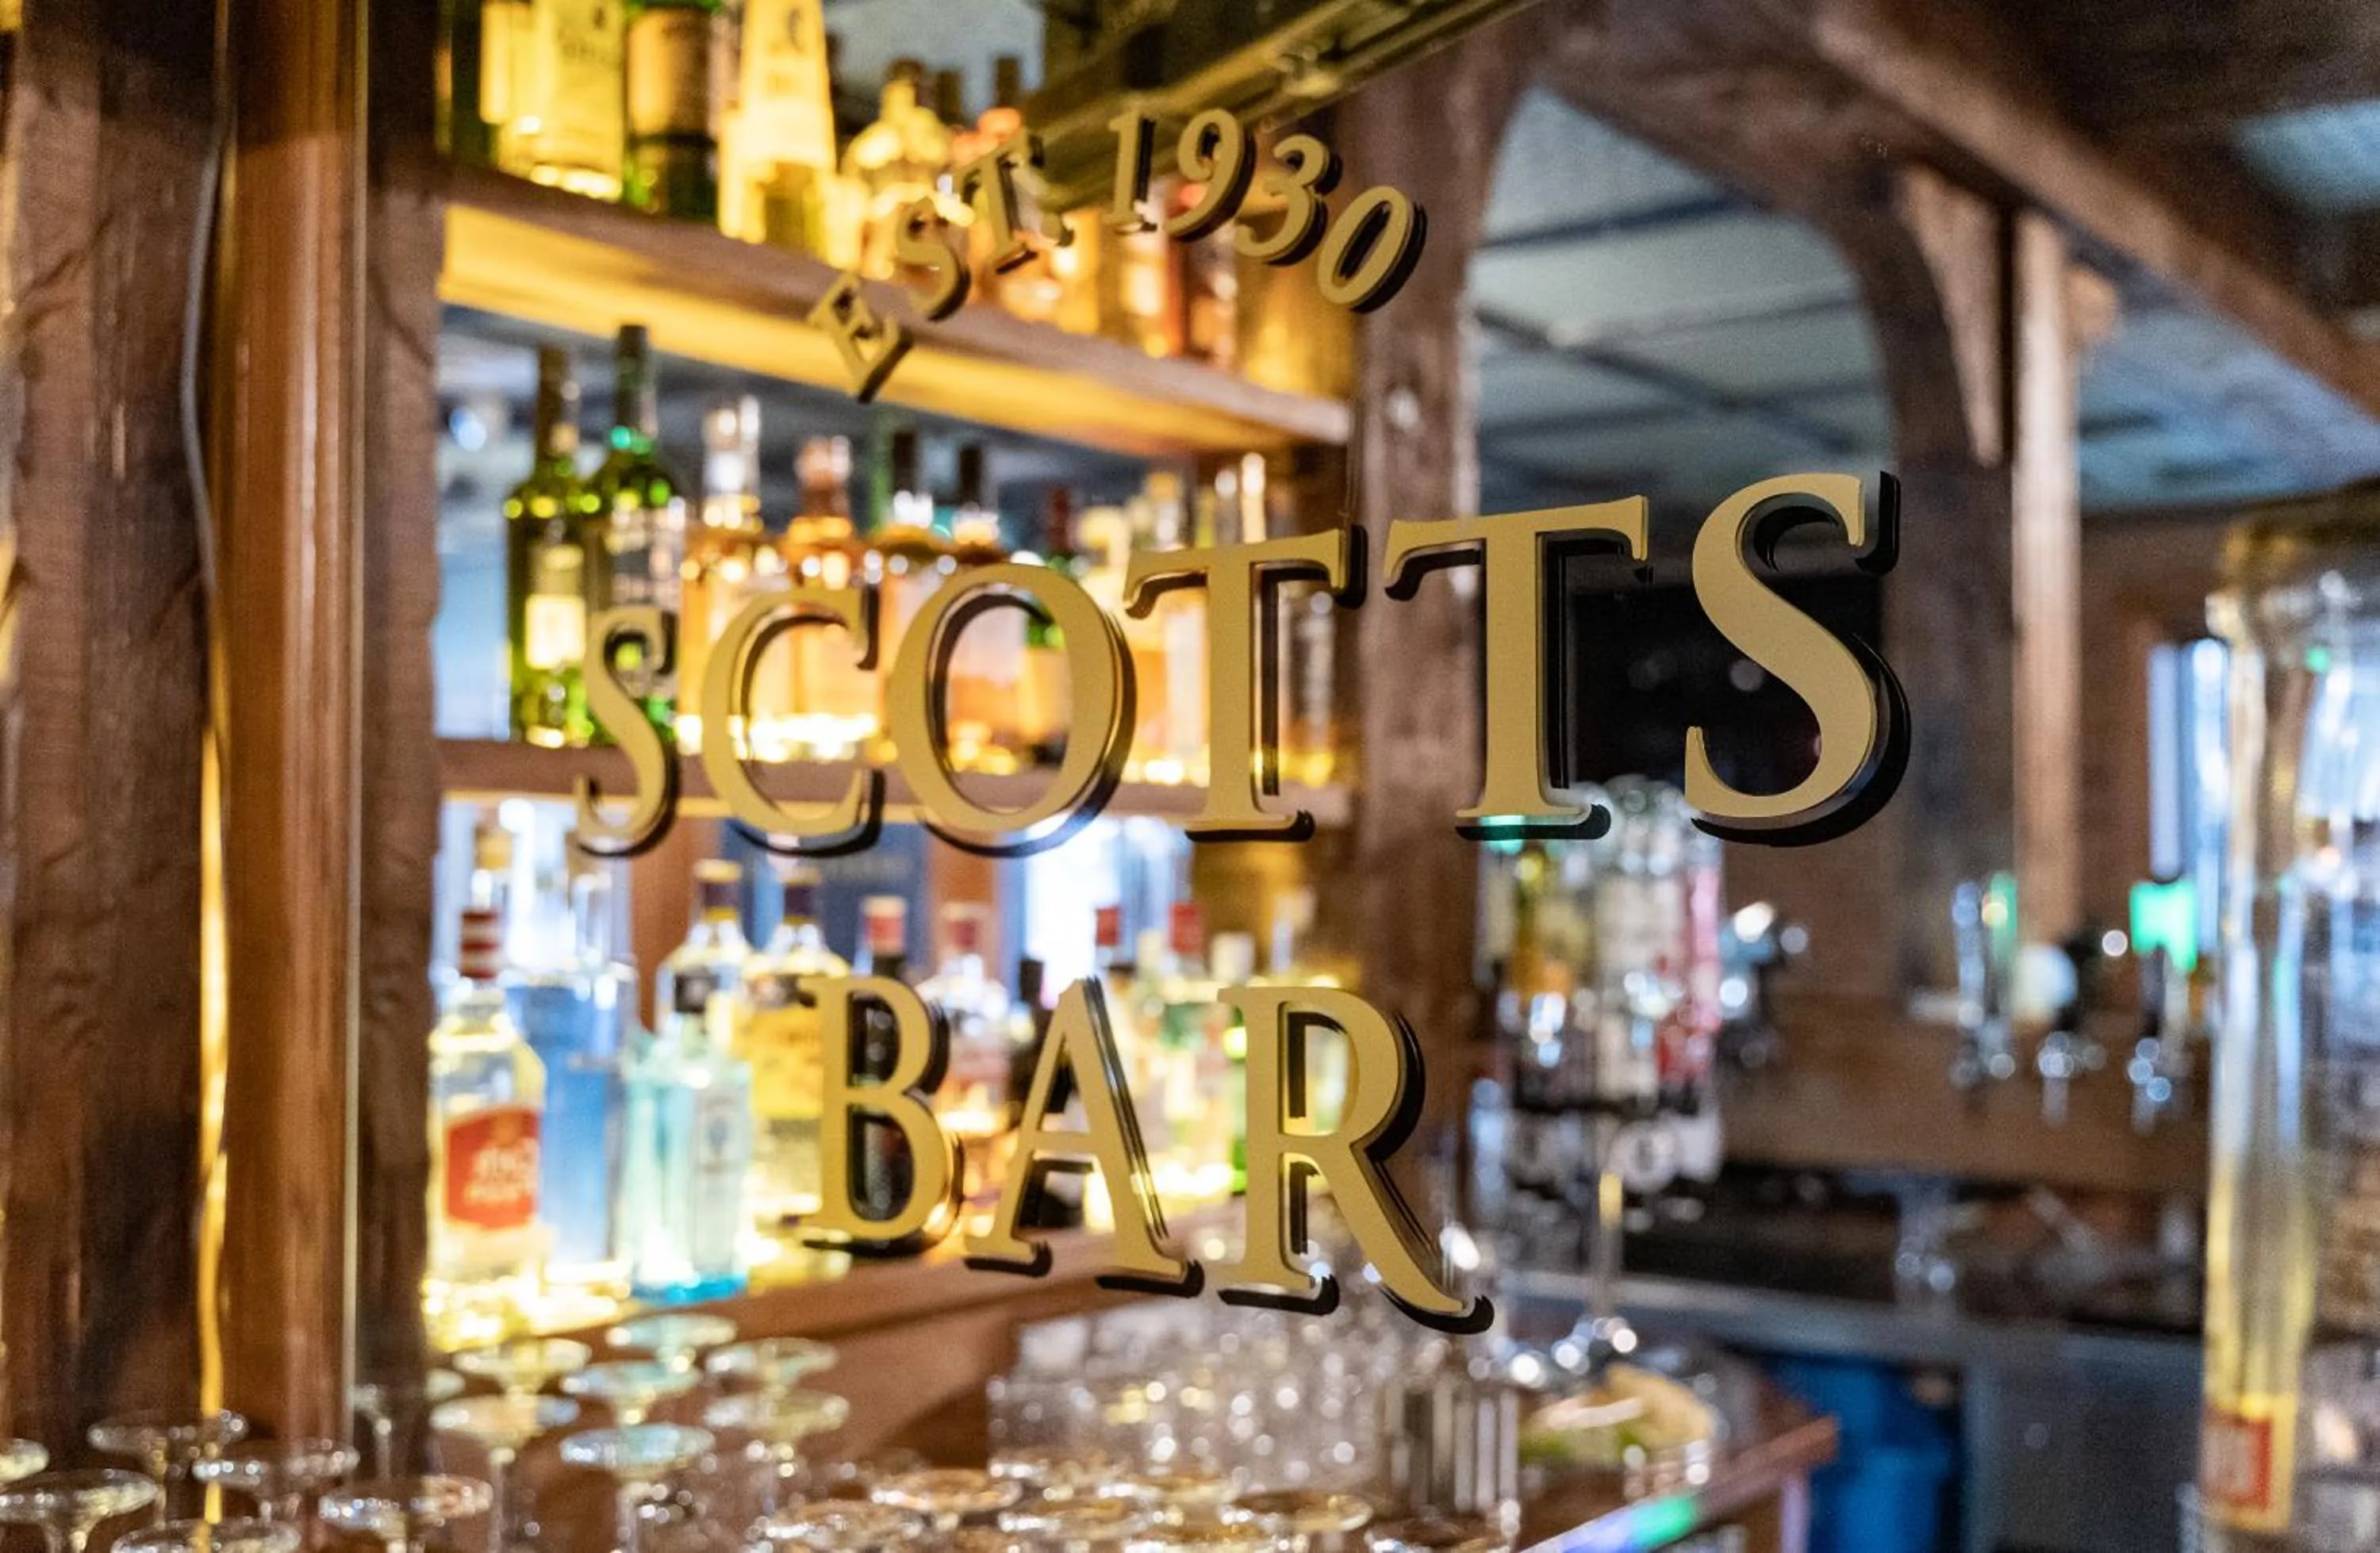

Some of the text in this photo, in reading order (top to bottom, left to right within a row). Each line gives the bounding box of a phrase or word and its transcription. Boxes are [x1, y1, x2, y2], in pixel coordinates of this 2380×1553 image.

[807, 108, 1425, 402] EST. 1930
[577, 473, 1907, 852] SCOTTS
[797, 976, 1491, 1331] BAR
